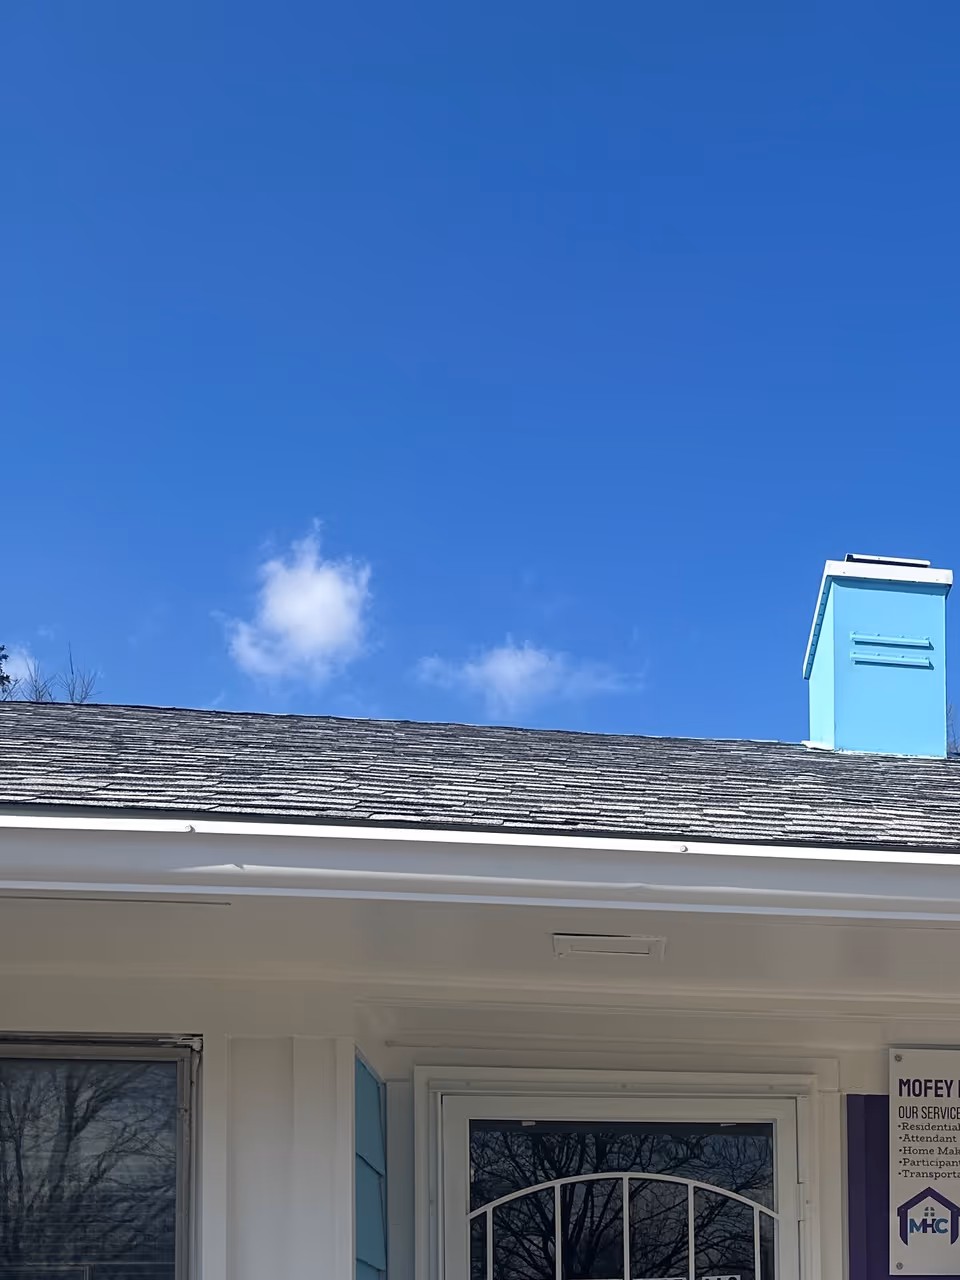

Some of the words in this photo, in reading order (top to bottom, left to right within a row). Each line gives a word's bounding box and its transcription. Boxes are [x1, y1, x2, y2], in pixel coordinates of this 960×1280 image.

[899, 1079, 954, 1097] MOFEY
[898, 1106, 919, 1119] OUR
[909, 1218, 949, 1234] MHC
